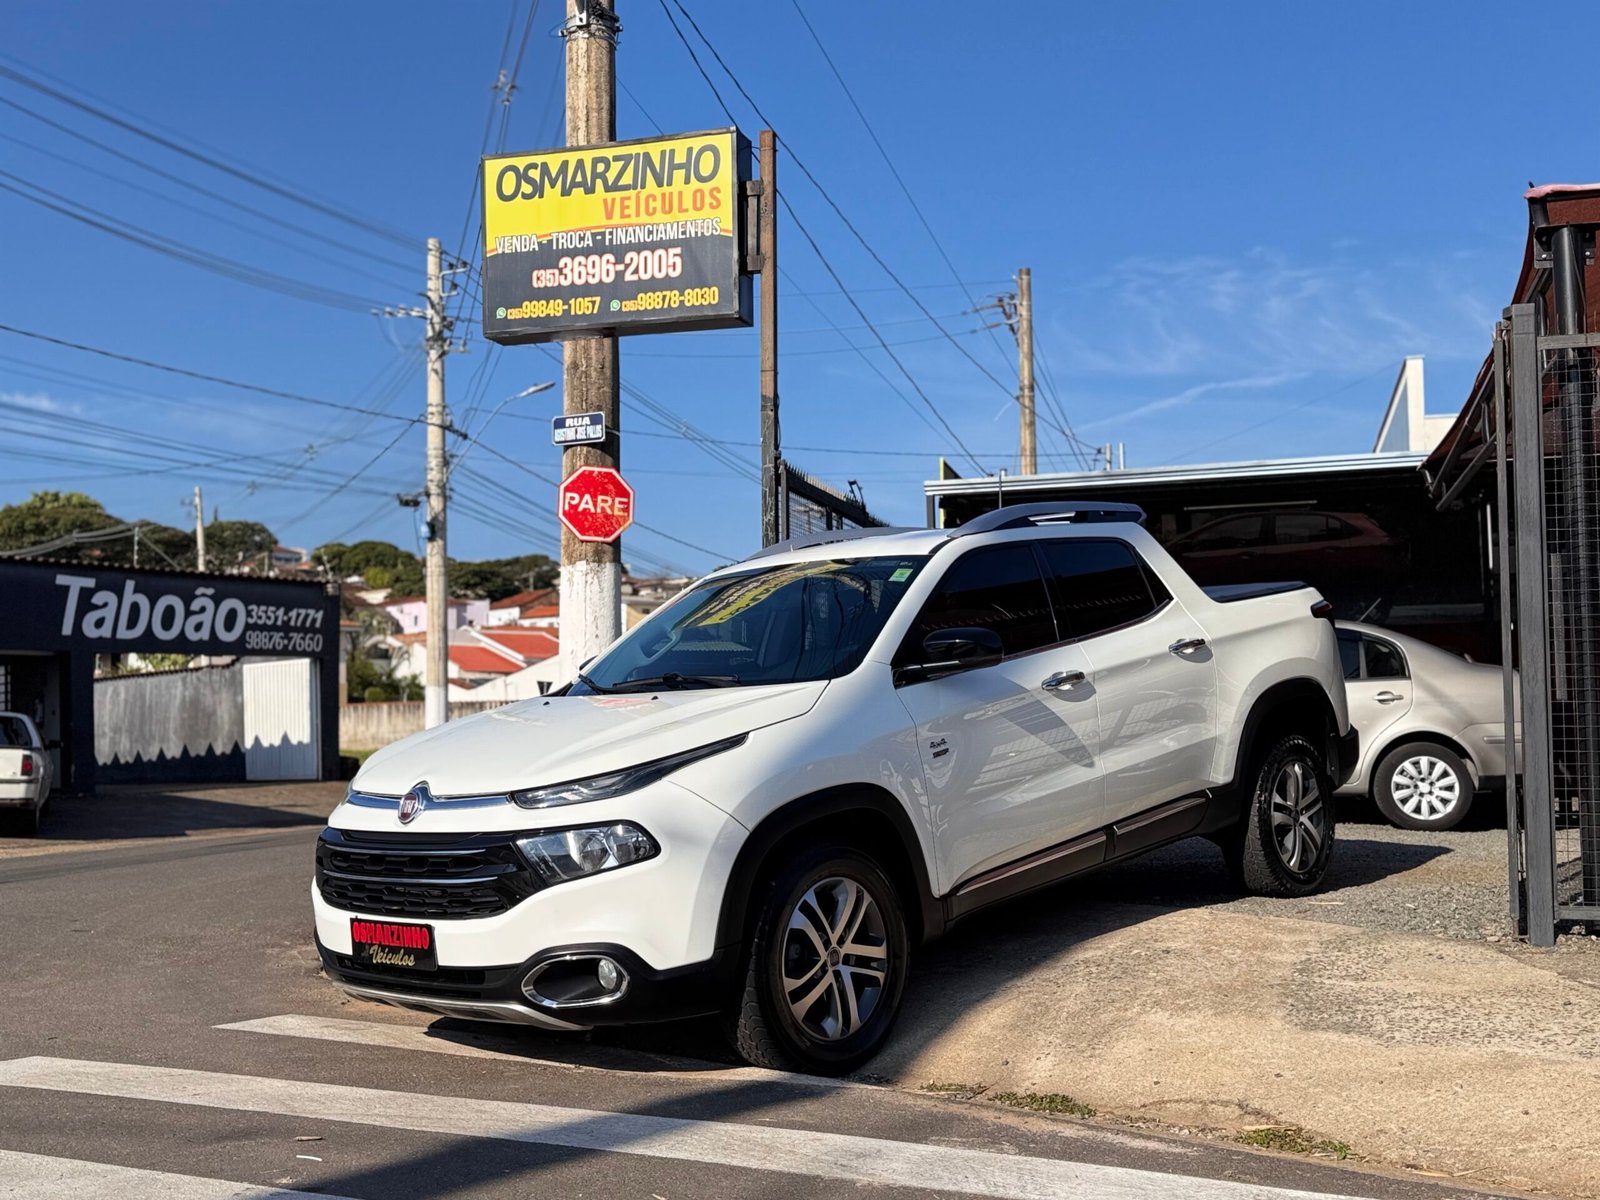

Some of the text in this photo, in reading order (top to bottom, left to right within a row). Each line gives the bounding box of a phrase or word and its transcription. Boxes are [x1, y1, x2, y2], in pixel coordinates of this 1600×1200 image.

[496, 144, 721, 202] OSMARZINHO
[602, 186, 722, 220] VEÍCULOS
[495, 234, 539, 254] VENDA
[550, 229, 593, 250] TROCA
[605, 217, 721, 246] FINANCIAMENTOS
[565, 416, 591, 427] RUA
[564, 492, 629, 517] PARE
[55, 574, 246, 642] Taboão
[352, 921, 430, 950] OSMARZINHO
